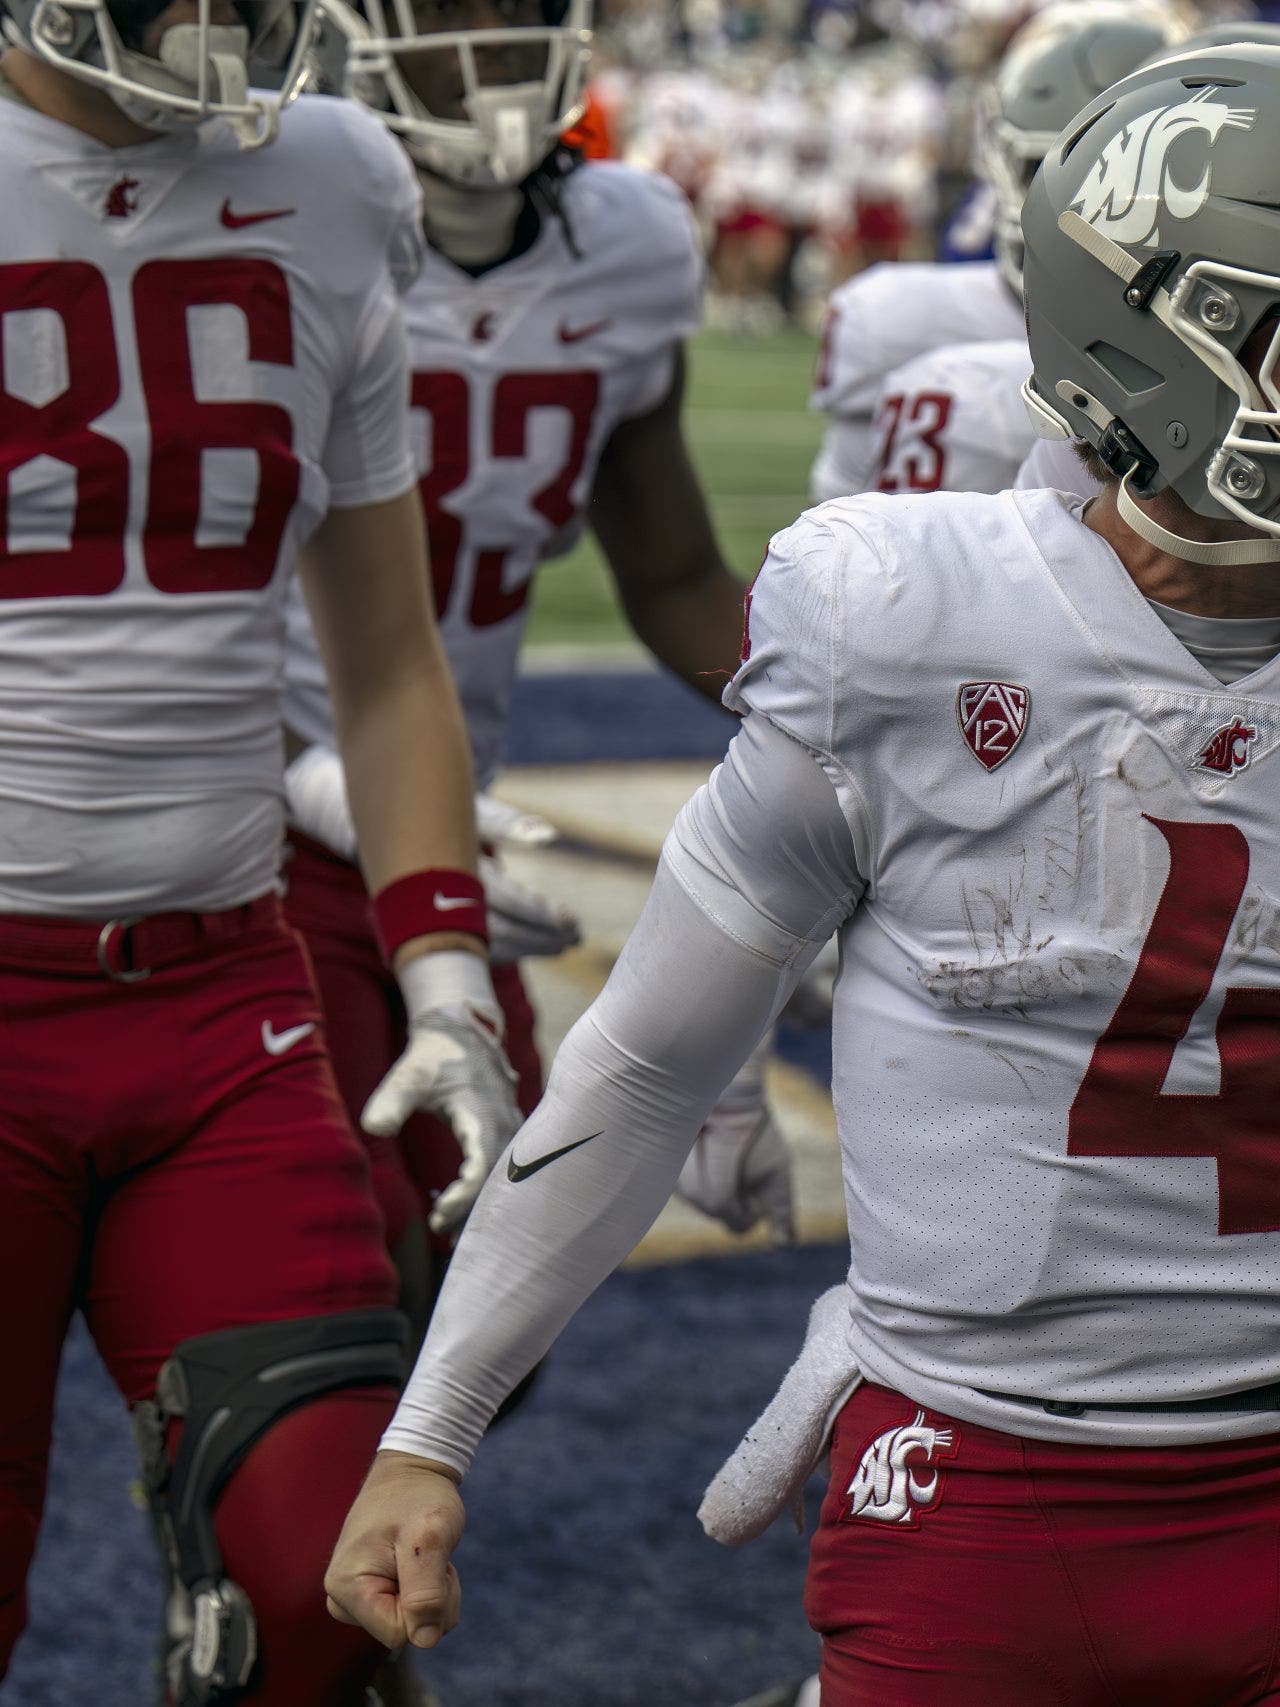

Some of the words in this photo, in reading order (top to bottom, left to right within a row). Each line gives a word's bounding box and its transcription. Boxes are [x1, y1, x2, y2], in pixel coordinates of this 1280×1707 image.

[0, 258, 301, 599] 86
[961, 684, 1026, 737] PAC
[975, 719, 1009, 751] 12
